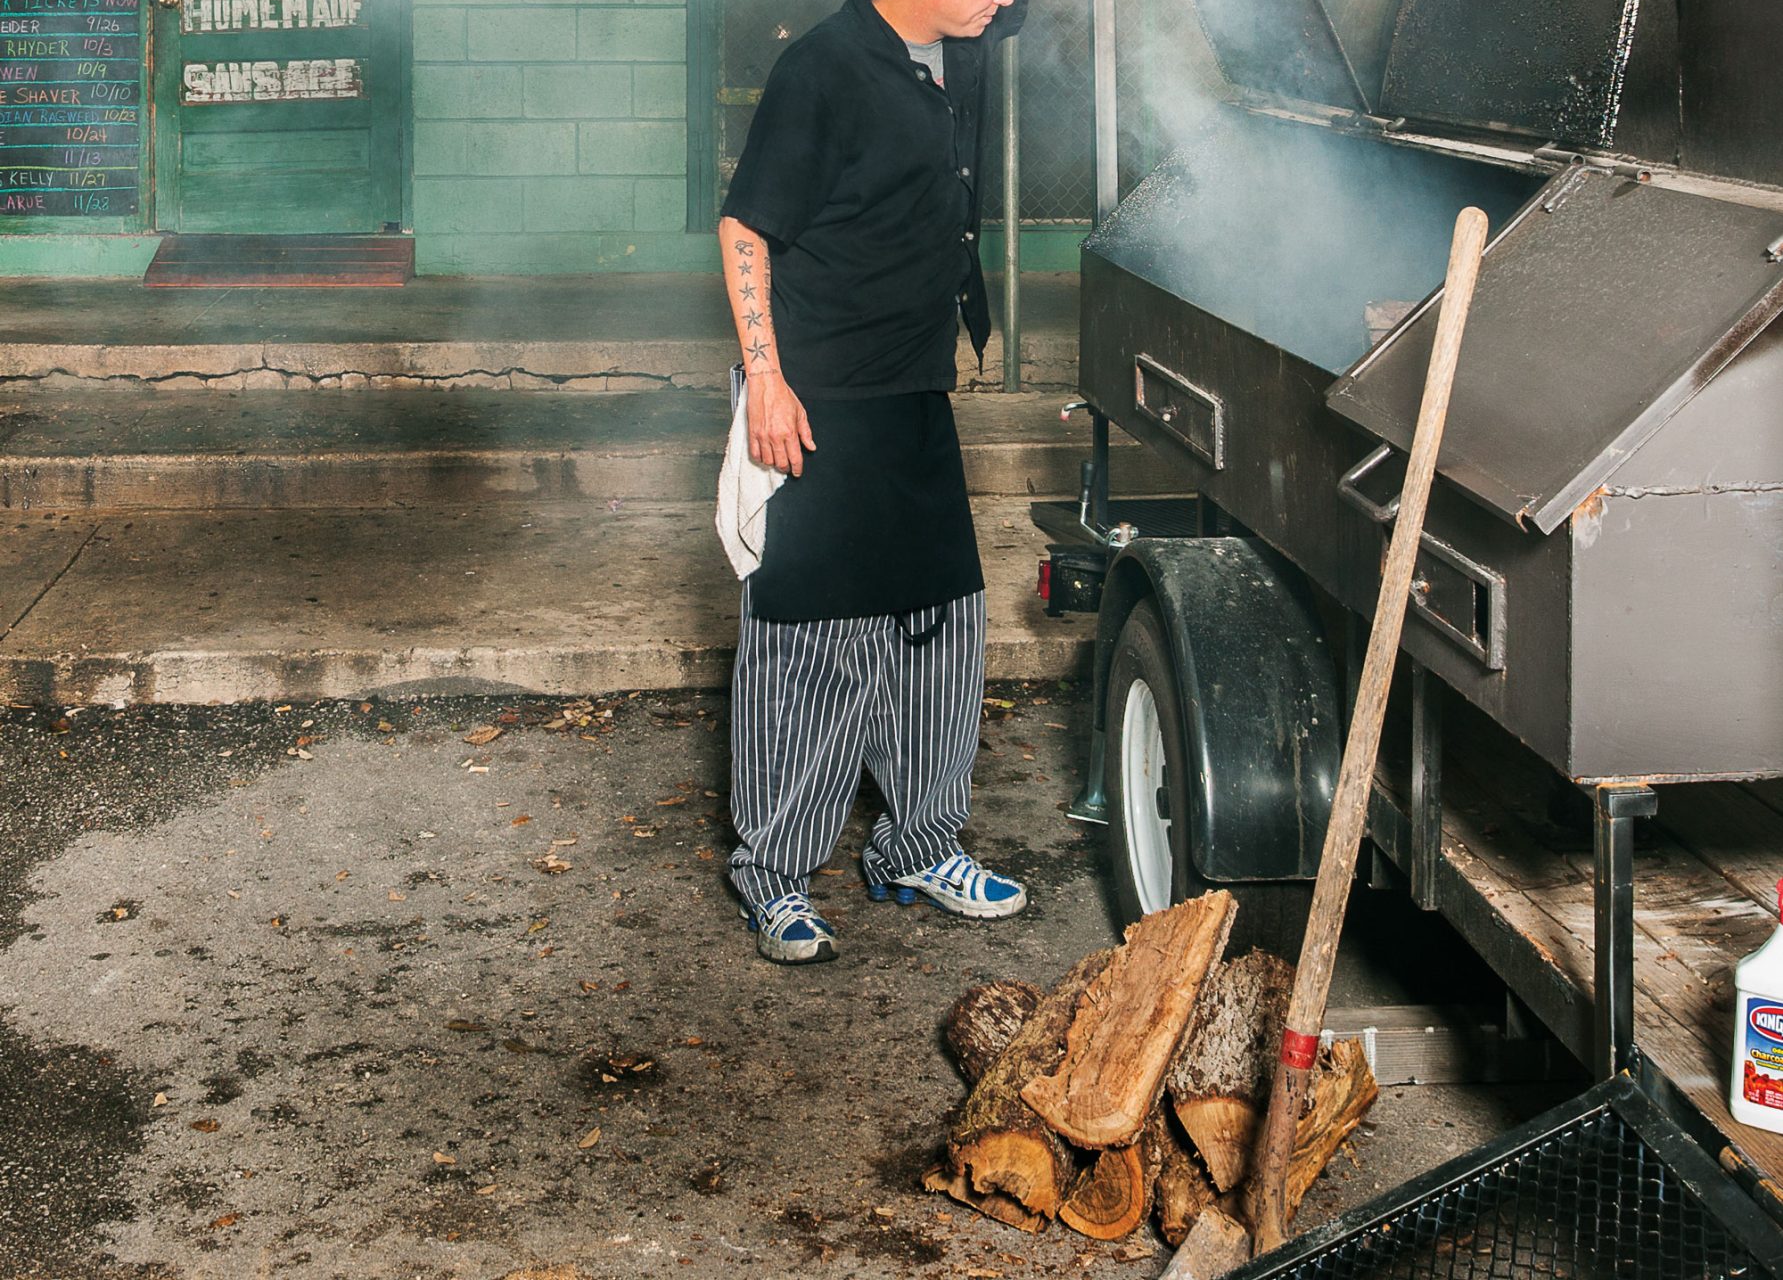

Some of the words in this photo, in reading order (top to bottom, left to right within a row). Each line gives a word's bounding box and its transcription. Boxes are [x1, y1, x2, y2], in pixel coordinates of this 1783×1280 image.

[6, 39, 70, 57] RHYDER
[83, 38, 113, 56] 10/3
[77, 61, 107, 78] 10/9
[14, 87, 80, 104] SHAVER
[91, 83, 131, 101] 10/10
[66, 125, 108, 143] 10/24
[65, 148, 101, 167] 11/13
[9, 171, 54, 186] KELLY
[69, 170, 105, 187] 11/27
[74, 192, 110, 213] 11/28
